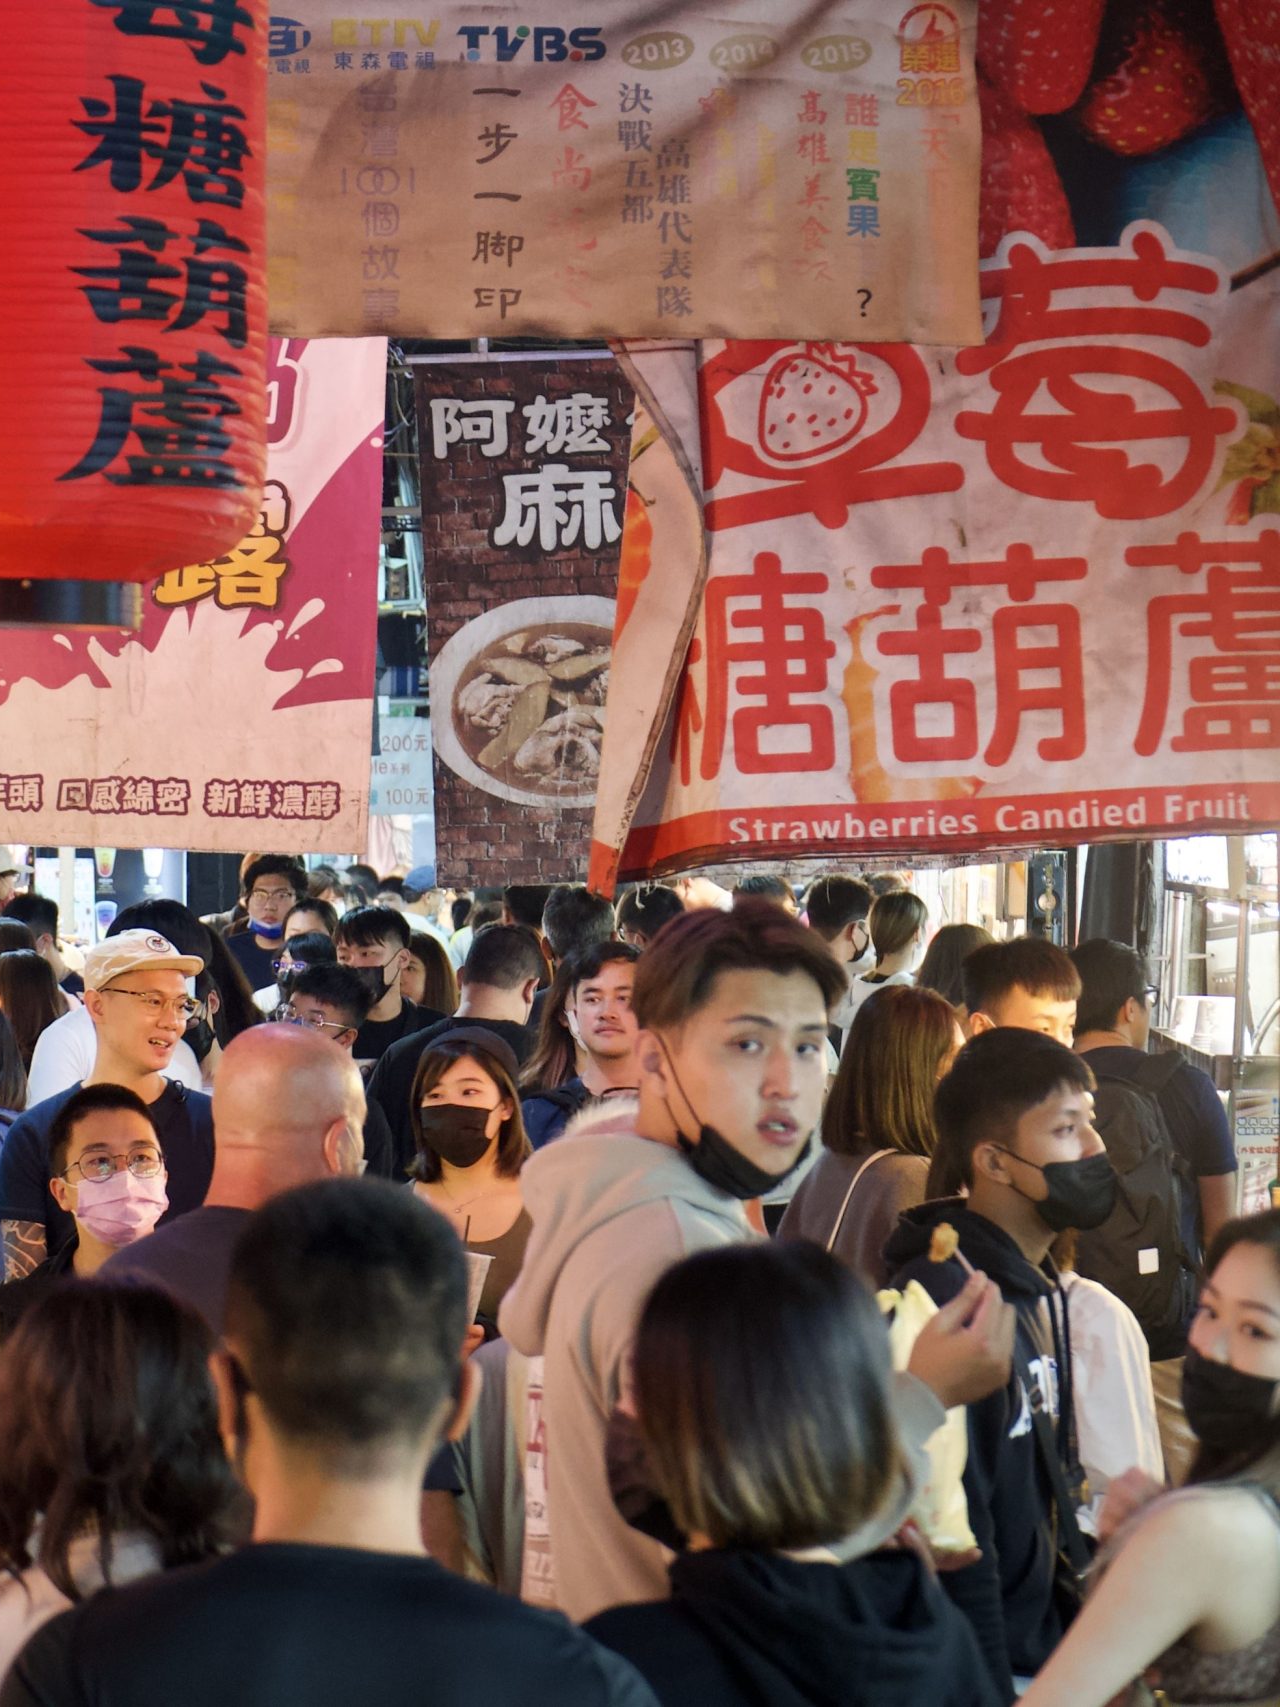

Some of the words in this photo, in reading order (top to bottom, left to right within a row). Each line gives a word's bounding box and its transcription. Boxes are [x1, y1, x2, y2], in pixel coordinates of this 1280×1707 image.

[456, 25, 607, 62] TVBS
[627, 38, 686, 65] 2013
[809, 42, 866, 66] 2015
[269, 57, 312, 74] 電視
[334, 51, 437, 71] 東森電視
[895, 77, 965, 107] 2016
[618, 82, 654, 224] 決戰五都
[656, 138, 694, 318] 高雄代表隊
[57, 778, 191, 815] 口感綿密
[202, 779, 341, 821] 新鮮濃醇
[728, 809, 978, 845] Strawberries
[995, 797, 1147, 834] Candied
[1165, 792, 1251, 824] Fruit
